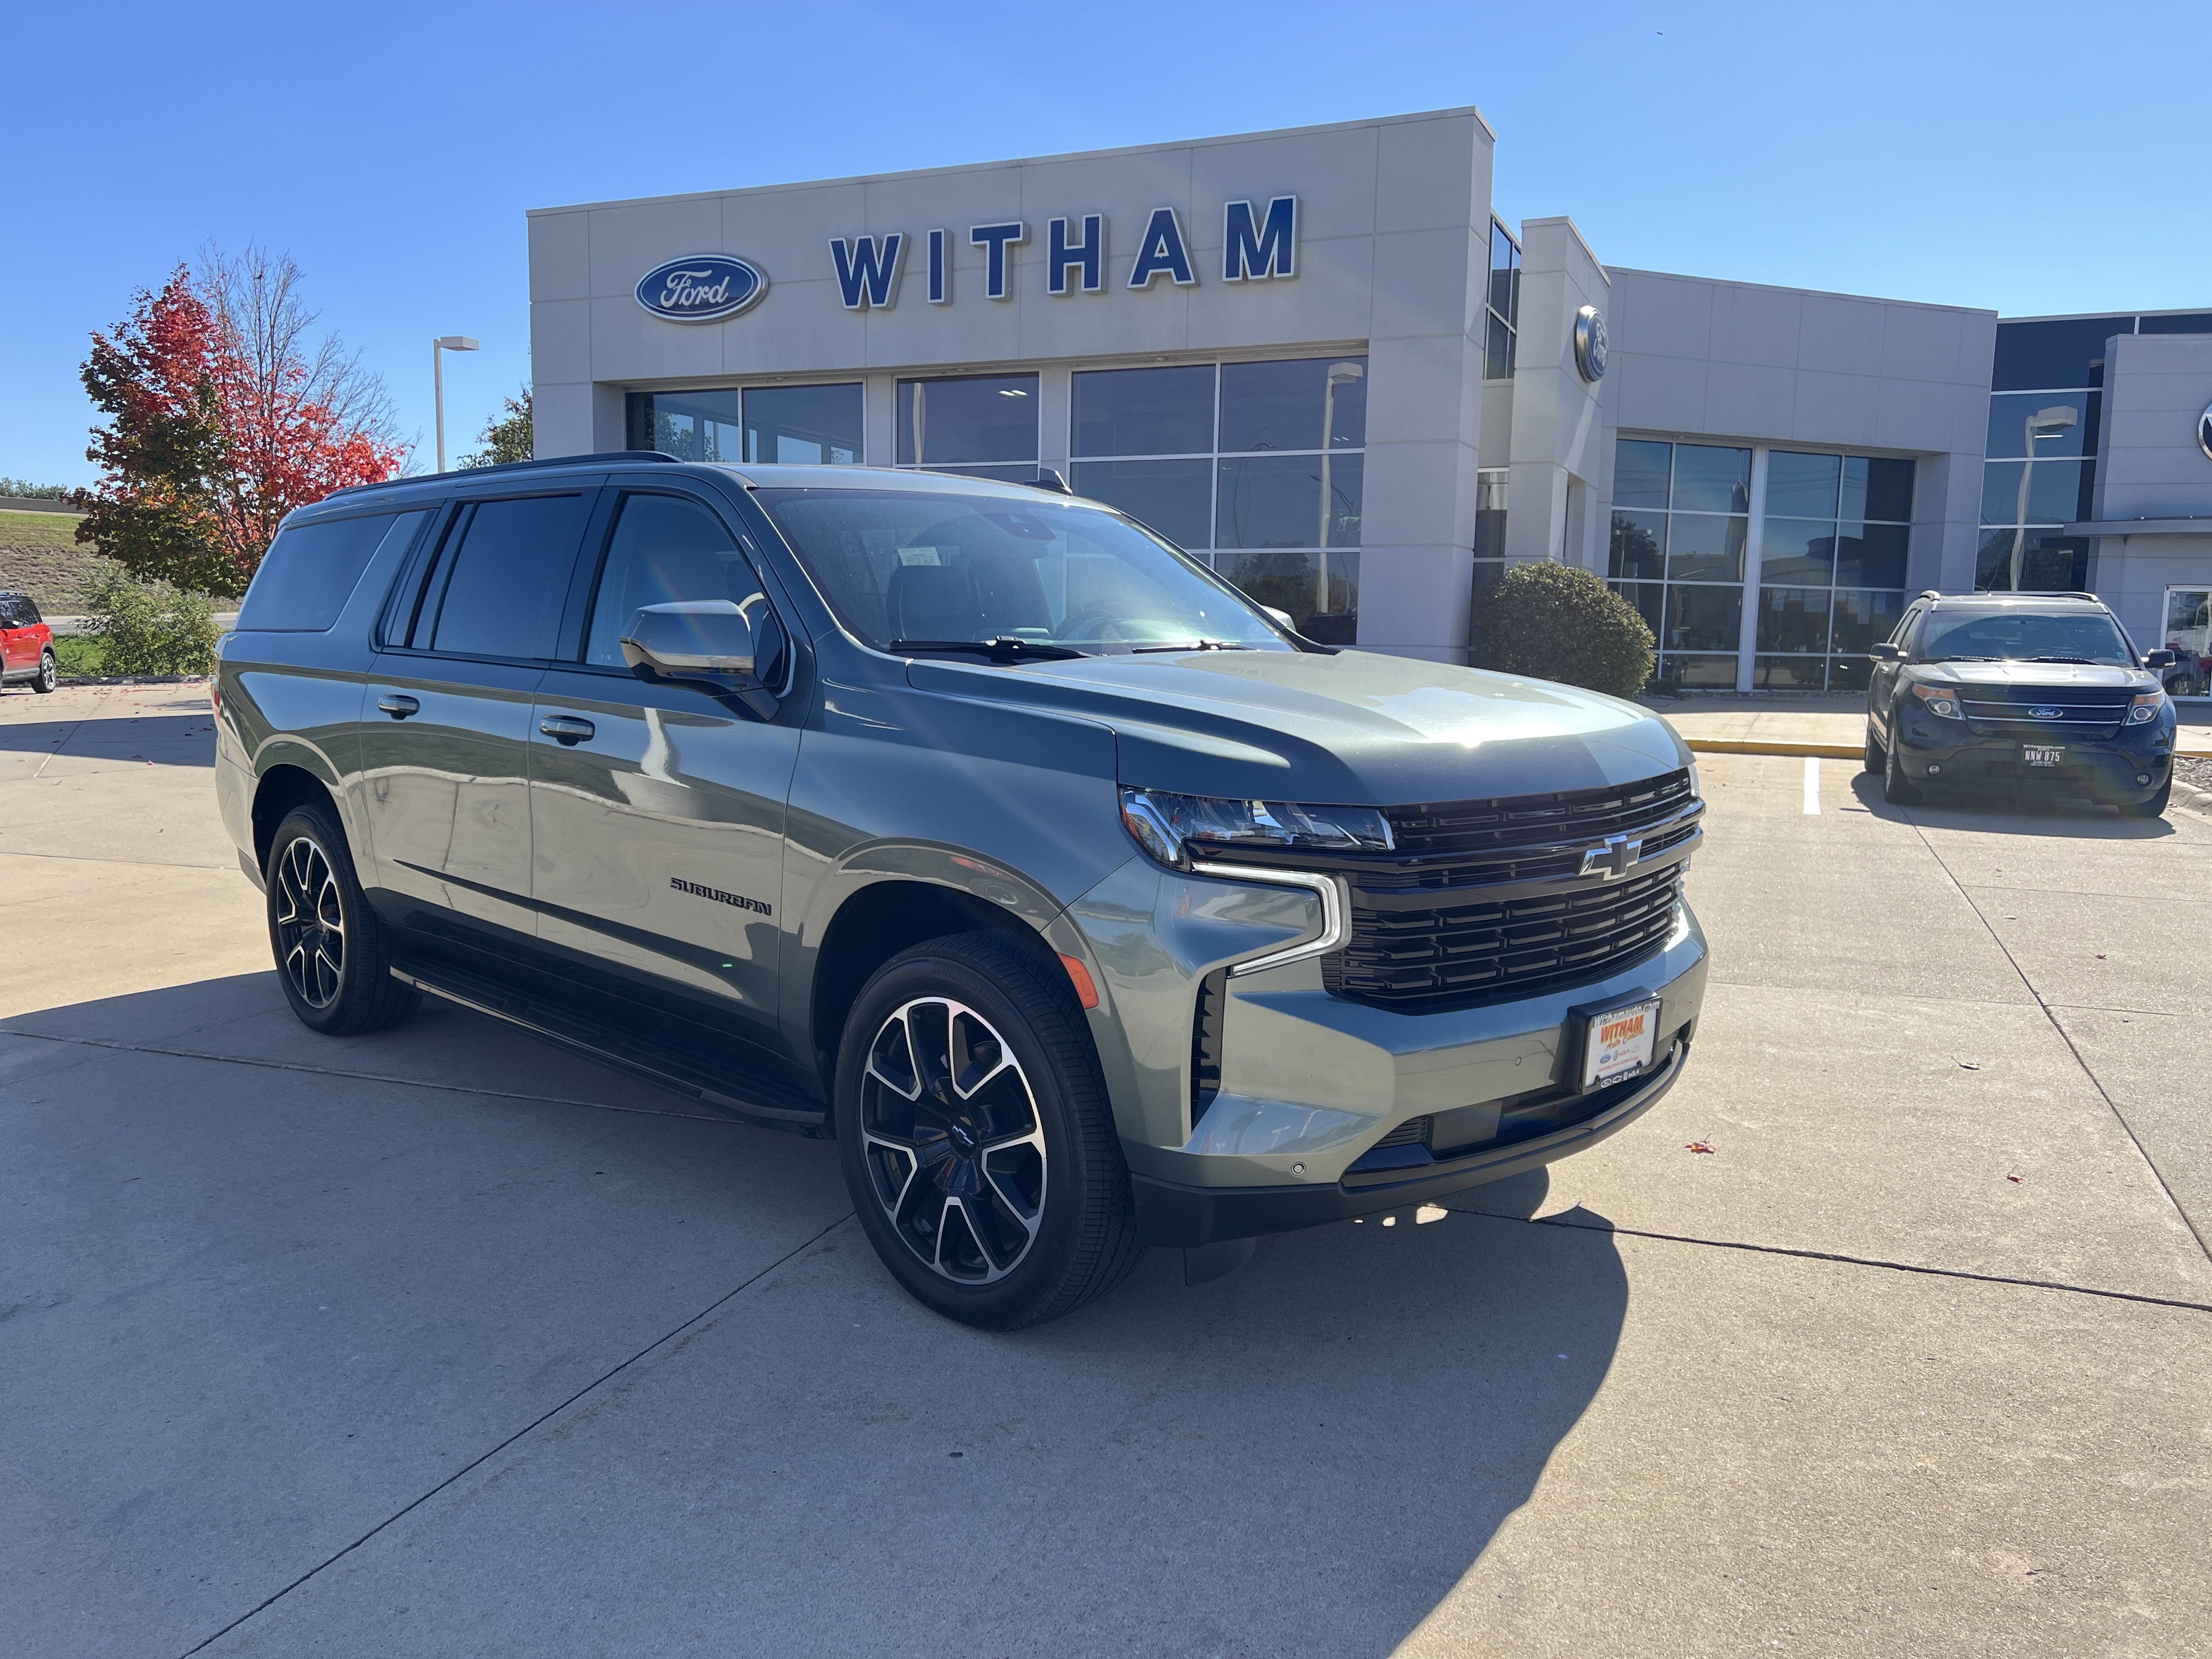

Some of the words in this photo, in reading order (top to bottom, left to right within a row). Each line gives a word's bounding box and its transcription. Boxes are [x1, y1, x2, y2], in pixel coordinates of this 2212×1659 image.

[827, 195, 1299, 311] WITHAM
[660, 269, 730, 308] Ford
[1593, 323, 1607, 367] Ford
[2025, 751, 2042, 761] NNW
[2045, 751, 2060, 762] 875
[670, 877, 772, 916] SUBURBAN
[1594, 1000, 1661, 1028] Withamauto.com
[1601, 1014, 1644, 1043] WITHAM
[1605, 1036, 1621, 1052] Auto
